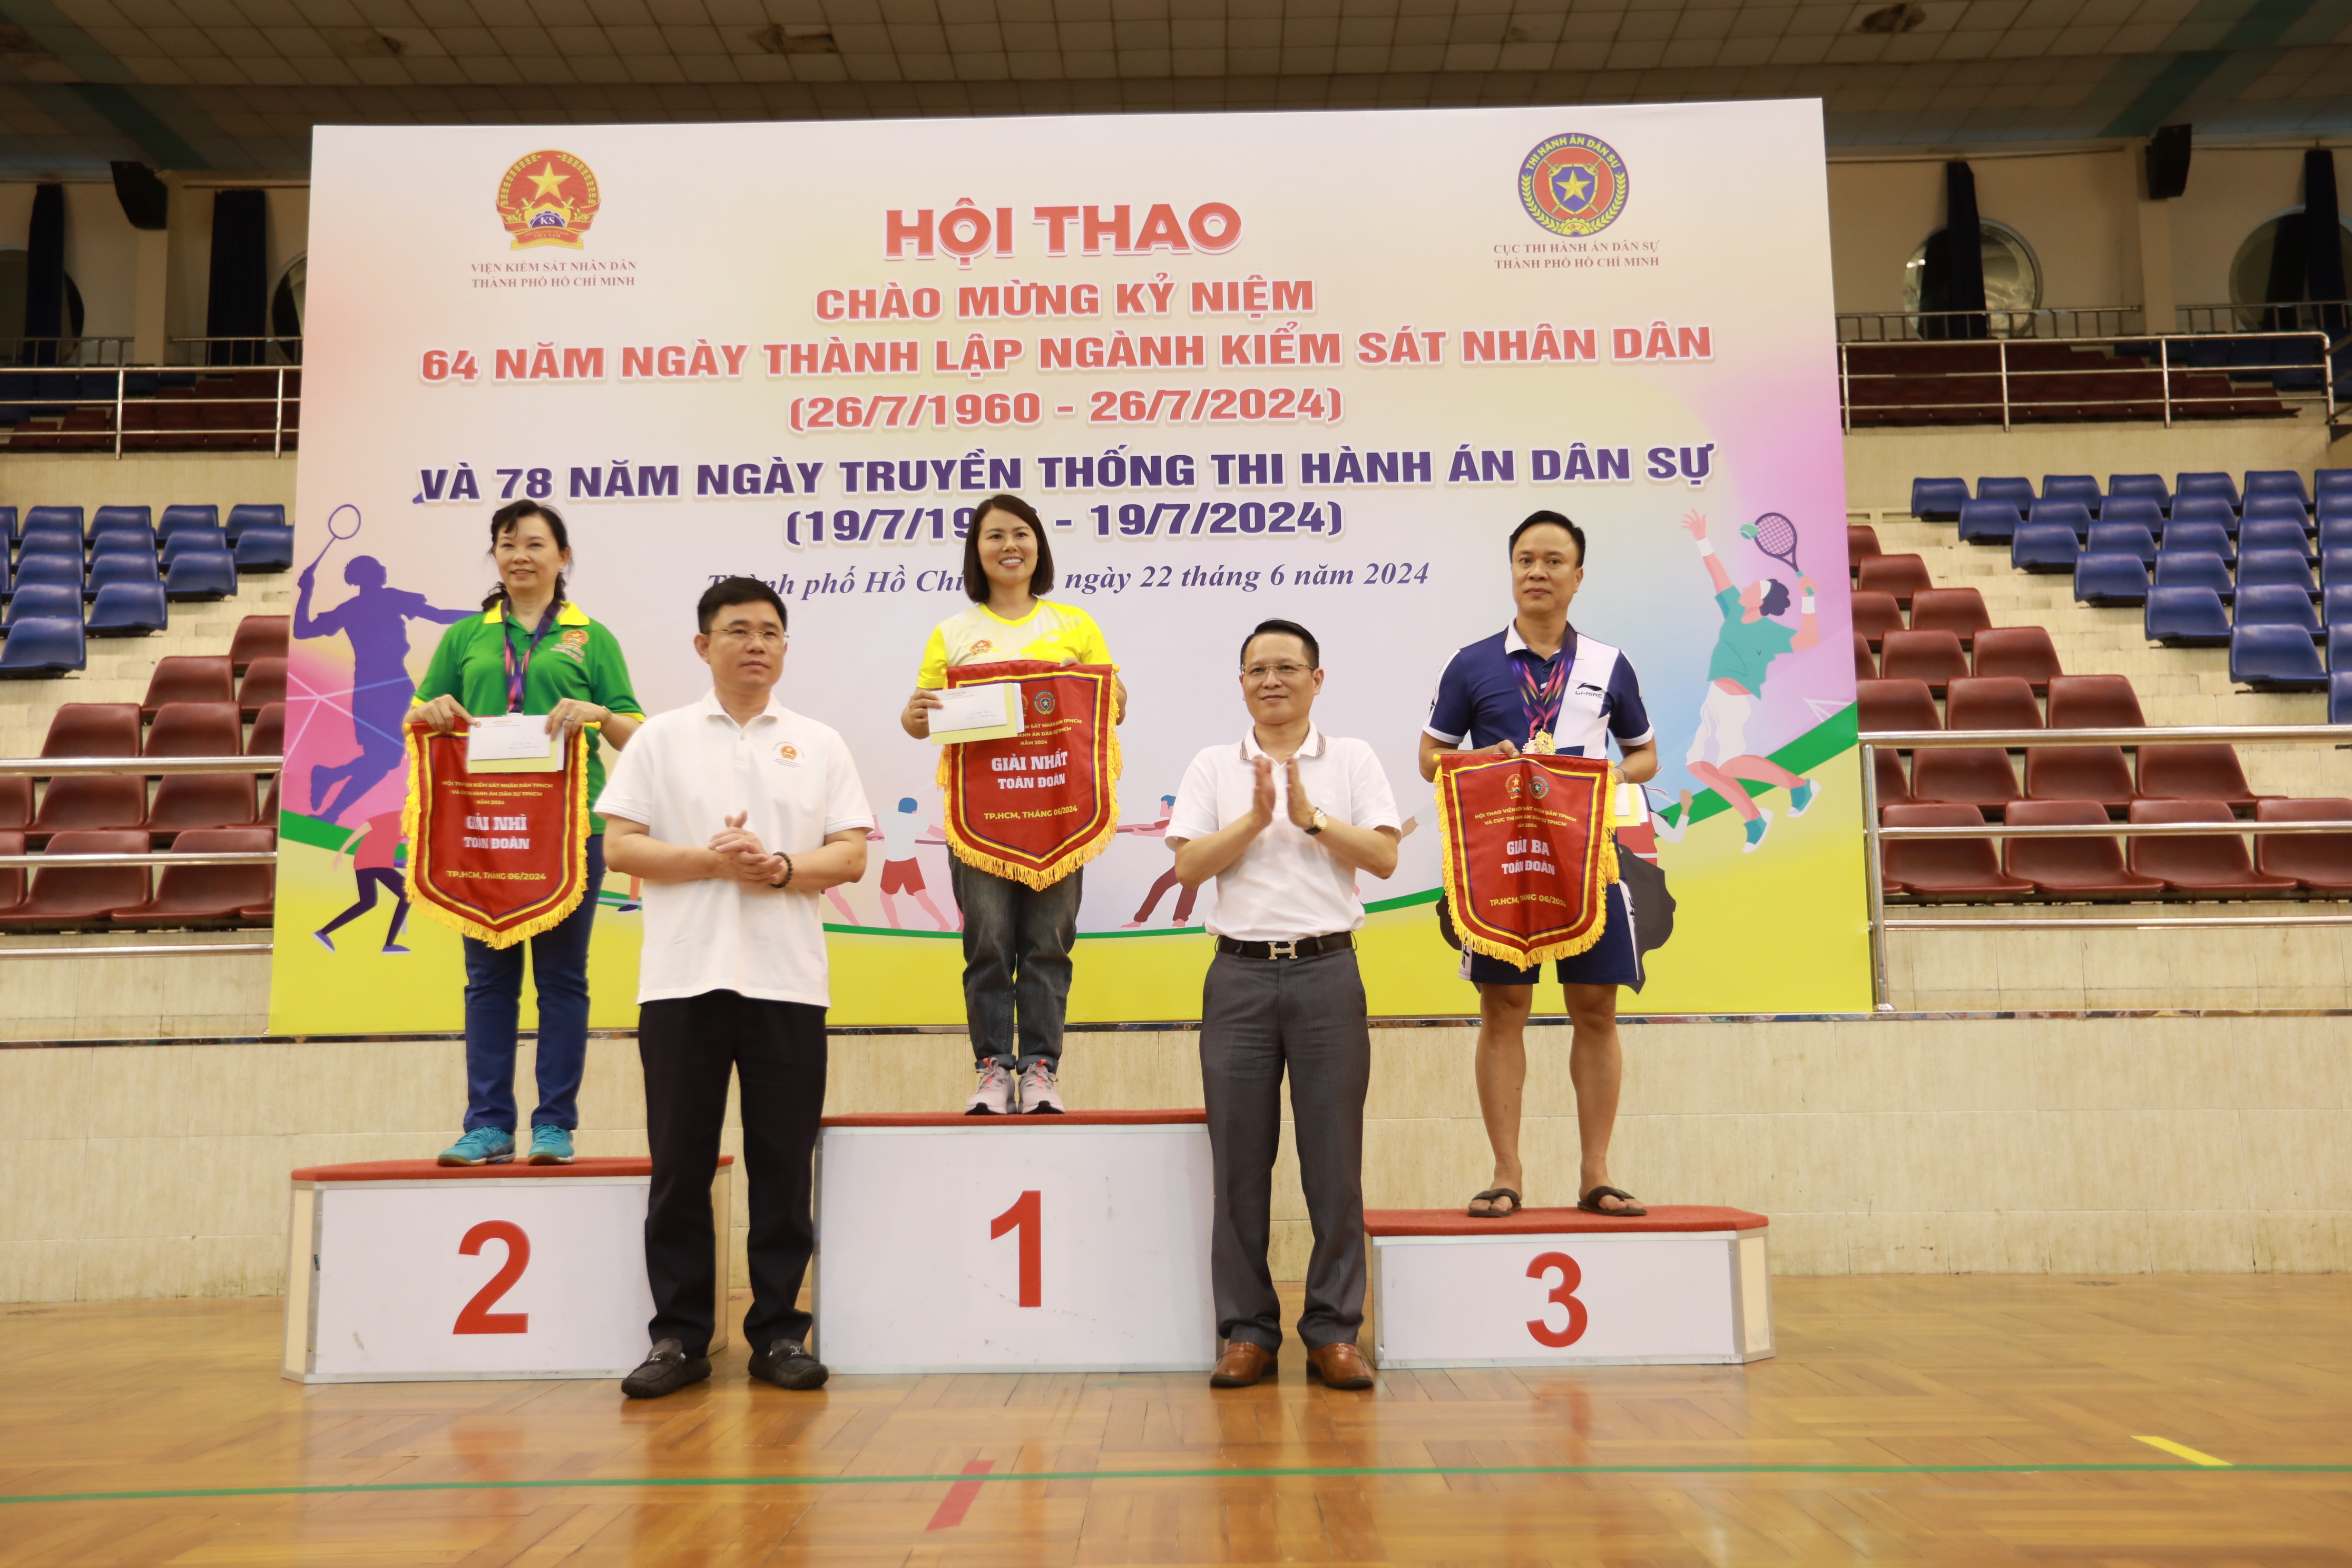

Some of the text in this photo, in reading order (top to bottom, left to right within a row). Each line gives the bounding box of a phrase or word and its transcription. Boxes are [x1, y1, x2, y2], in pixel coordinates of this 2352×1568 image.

[1525, 134, 1622, 170] THI HÀNH ÁN DÂN SỰ
[887, 198, 1241, 264] HỘI THAO
[1493, 240, 1660, 256] CỤC THI HÀNH ÁN DÂN SỰ
[471, 259, 636, 274] VIỆN KIỂM SÁT NHÂN DÂN
[1495, 256, 1659, 269] THÀNH PHỐ HỒ CHÍ MINH
[472, 275, 635, 288] THÀNH PHỐ HỒ CHÍ MINH
[818, 273, 1312, 319] CHÀO MỪNG KỶ NIỆM
[423, 321, 1710, 380] 64 NĂM NGÀY THÀNH LẬP NGÀNH KIỂM SÁT NHÂN DÂN
[791, 393, 1039, 431] (26/7/1960
[1092, 388, 1340, 421] 26/7/2024)
[422, 443, 1713, 499] VÀ 78 NĂM NGÀY TRUYỀN THỐNG THI HÀNH ÁN DÂN SỰ
[1092, 502, 1341, 535] 19/7/2024)
[802, 566, 855, 600] phố
[866, 565, 905, 592] Hồ
[916, 565, 964, 592] Chí
[1066, 567, 1131, 593] ngày
[1141, 566, 1172, 586] 22
[1182, 565, 1260, 591] tháng
[1271, 565, 1283, 585] 6
[1295, 565, 1353, 584] năm
[1364, 563, 1428, 584] 2024
[991, 748, 1068, 771] GIẢI NHẤT
[998, 773, 1065, 789] TOÀN ĐOÀN
[467, 813, 527, 830] GIẢI NHÌ
[984, 805, 1077, 820] TP.HCM, THÁNG 06/2024
[1558, 813, 1576, 822] TPHCM
[464, 836, 530, 849] TOÀN ĐOÀN
[1507, 836, 1550, 856] GIẢI BA
[447, 870, 546, 880] TP.HCM, THÁNG 06/2024
[1502, 860, 1555, 875] TOÀN ĐOÀN
[1490, 896, 1520, 906] TP.HCM,
[1539, 895, 1566, 907] 06/2024
[991, 1191, 1041, 1307] 1
[453, 1220, 530, 1335] 2
[1526, 1252, 1587, 1348] 3
